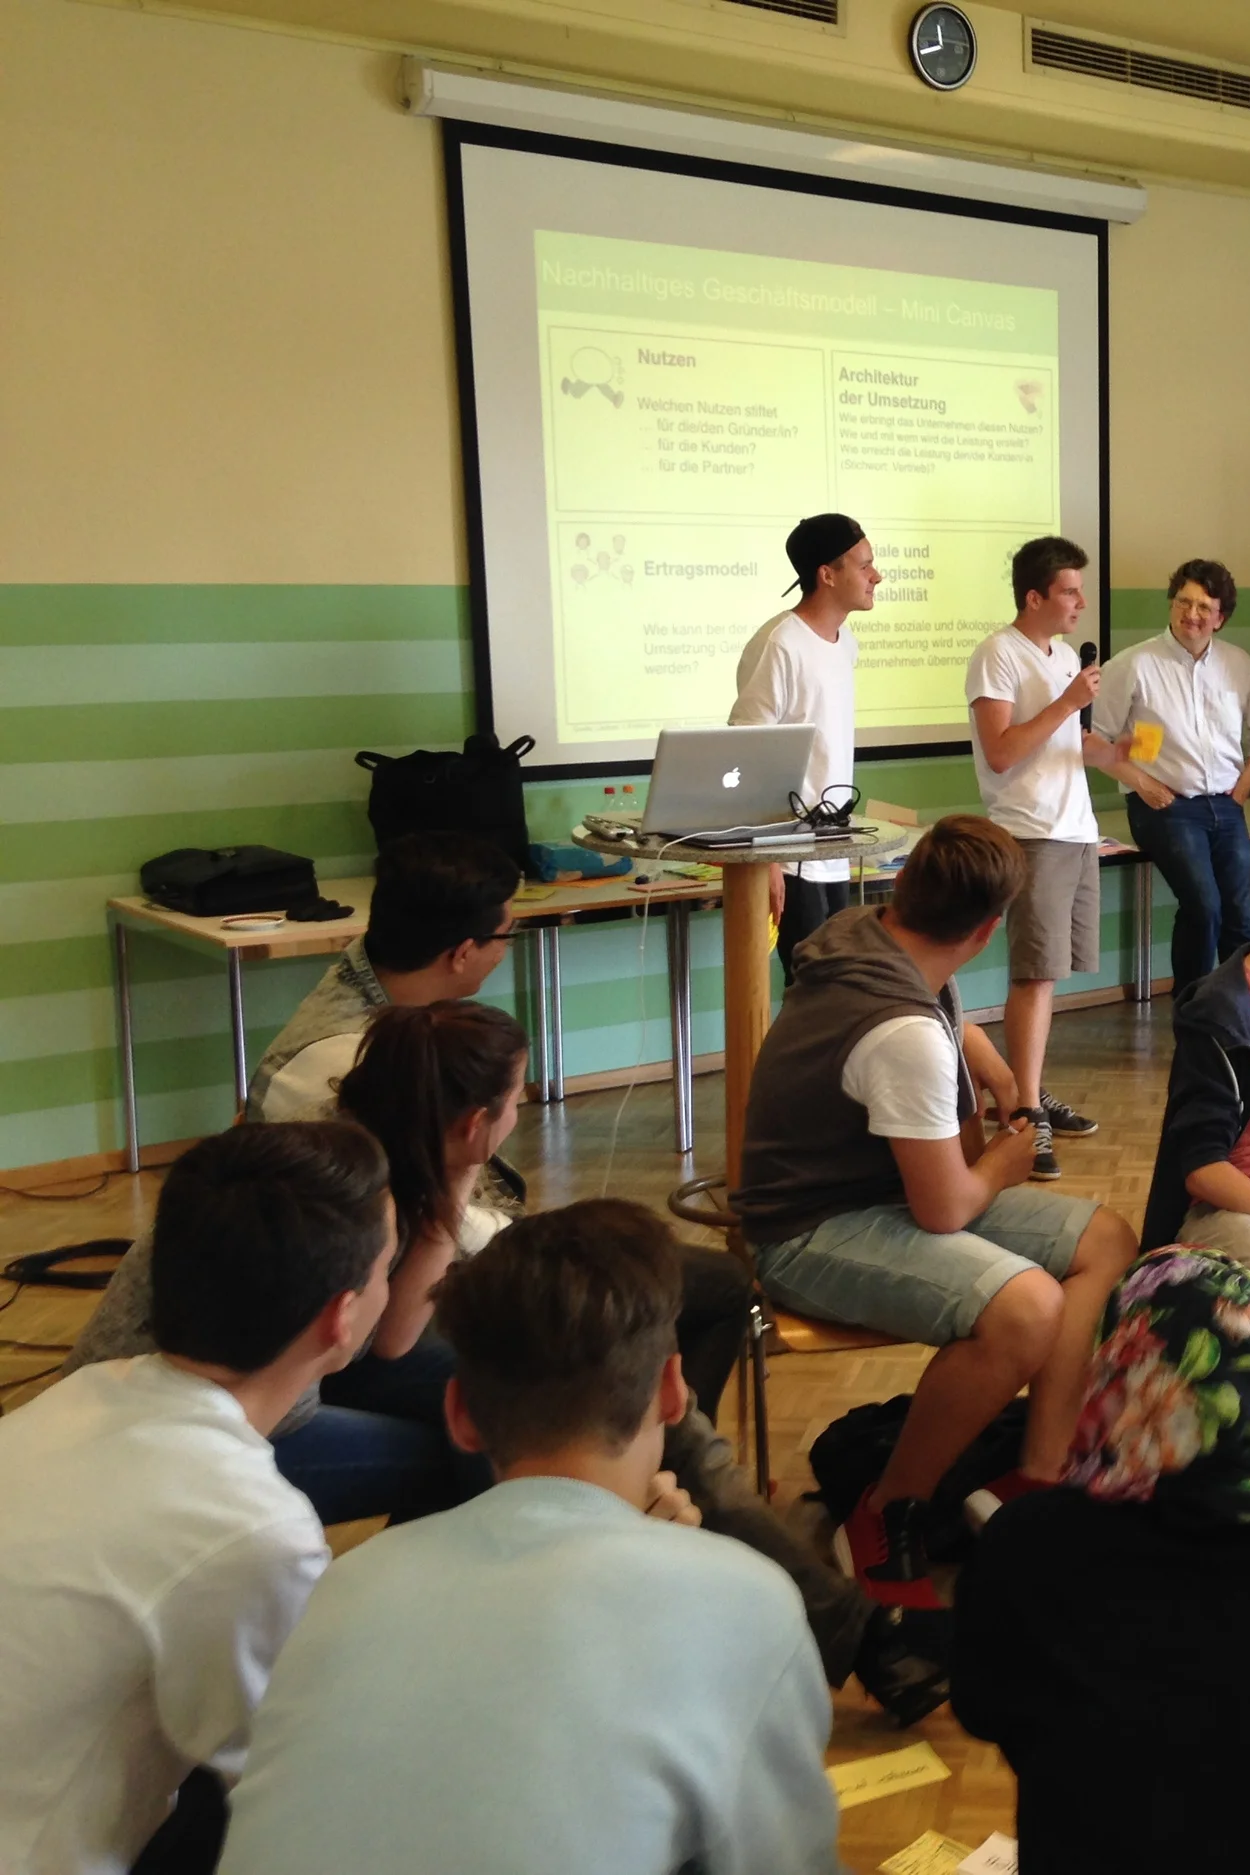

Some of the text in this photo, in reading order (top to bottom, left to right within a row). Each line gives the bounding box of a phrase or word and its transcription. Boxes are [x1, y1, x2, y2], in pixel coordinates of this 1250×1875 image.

[541, 259, 696, 302] Nachhaltiges
[701, 276, 877, 317] Geschäftsmodell
[900, 298, 941, 324] Mini
[946, 303, 1017, 333] Canvas
[637, 348, 697, 368] Nutzen
[838, 366, 920, 388] Architektur
[636, 397, 779, 418] Welchen Nutzen stiftet
[838, 389, 947, 415] der Umsetzung
[656, 418, 674, 432] für
[657, 438, 757, 455] für die Kunden?
[658, 458, 755, 475] für die Partner?
[874, 544, 931, 559] iale und
[643, 560, 759, 580] Ertragsmodell
[876, 565, 935, 584] ogische
[874, 586, 929, 602] sibilität
[642, 623, 669, 636] Wie
[671, 623, 703, 636] kann
[849, 620, 891, 633] Welche
[893, 619, 932, 632] soziale
[934, 619, 954, 631] und
[643, 643, 716, 658] Umsetzung
[857, 638, 929, 652] erantwortung
[931, 637, 954, 648] wird
[644, 660, 700, 675] werden?
